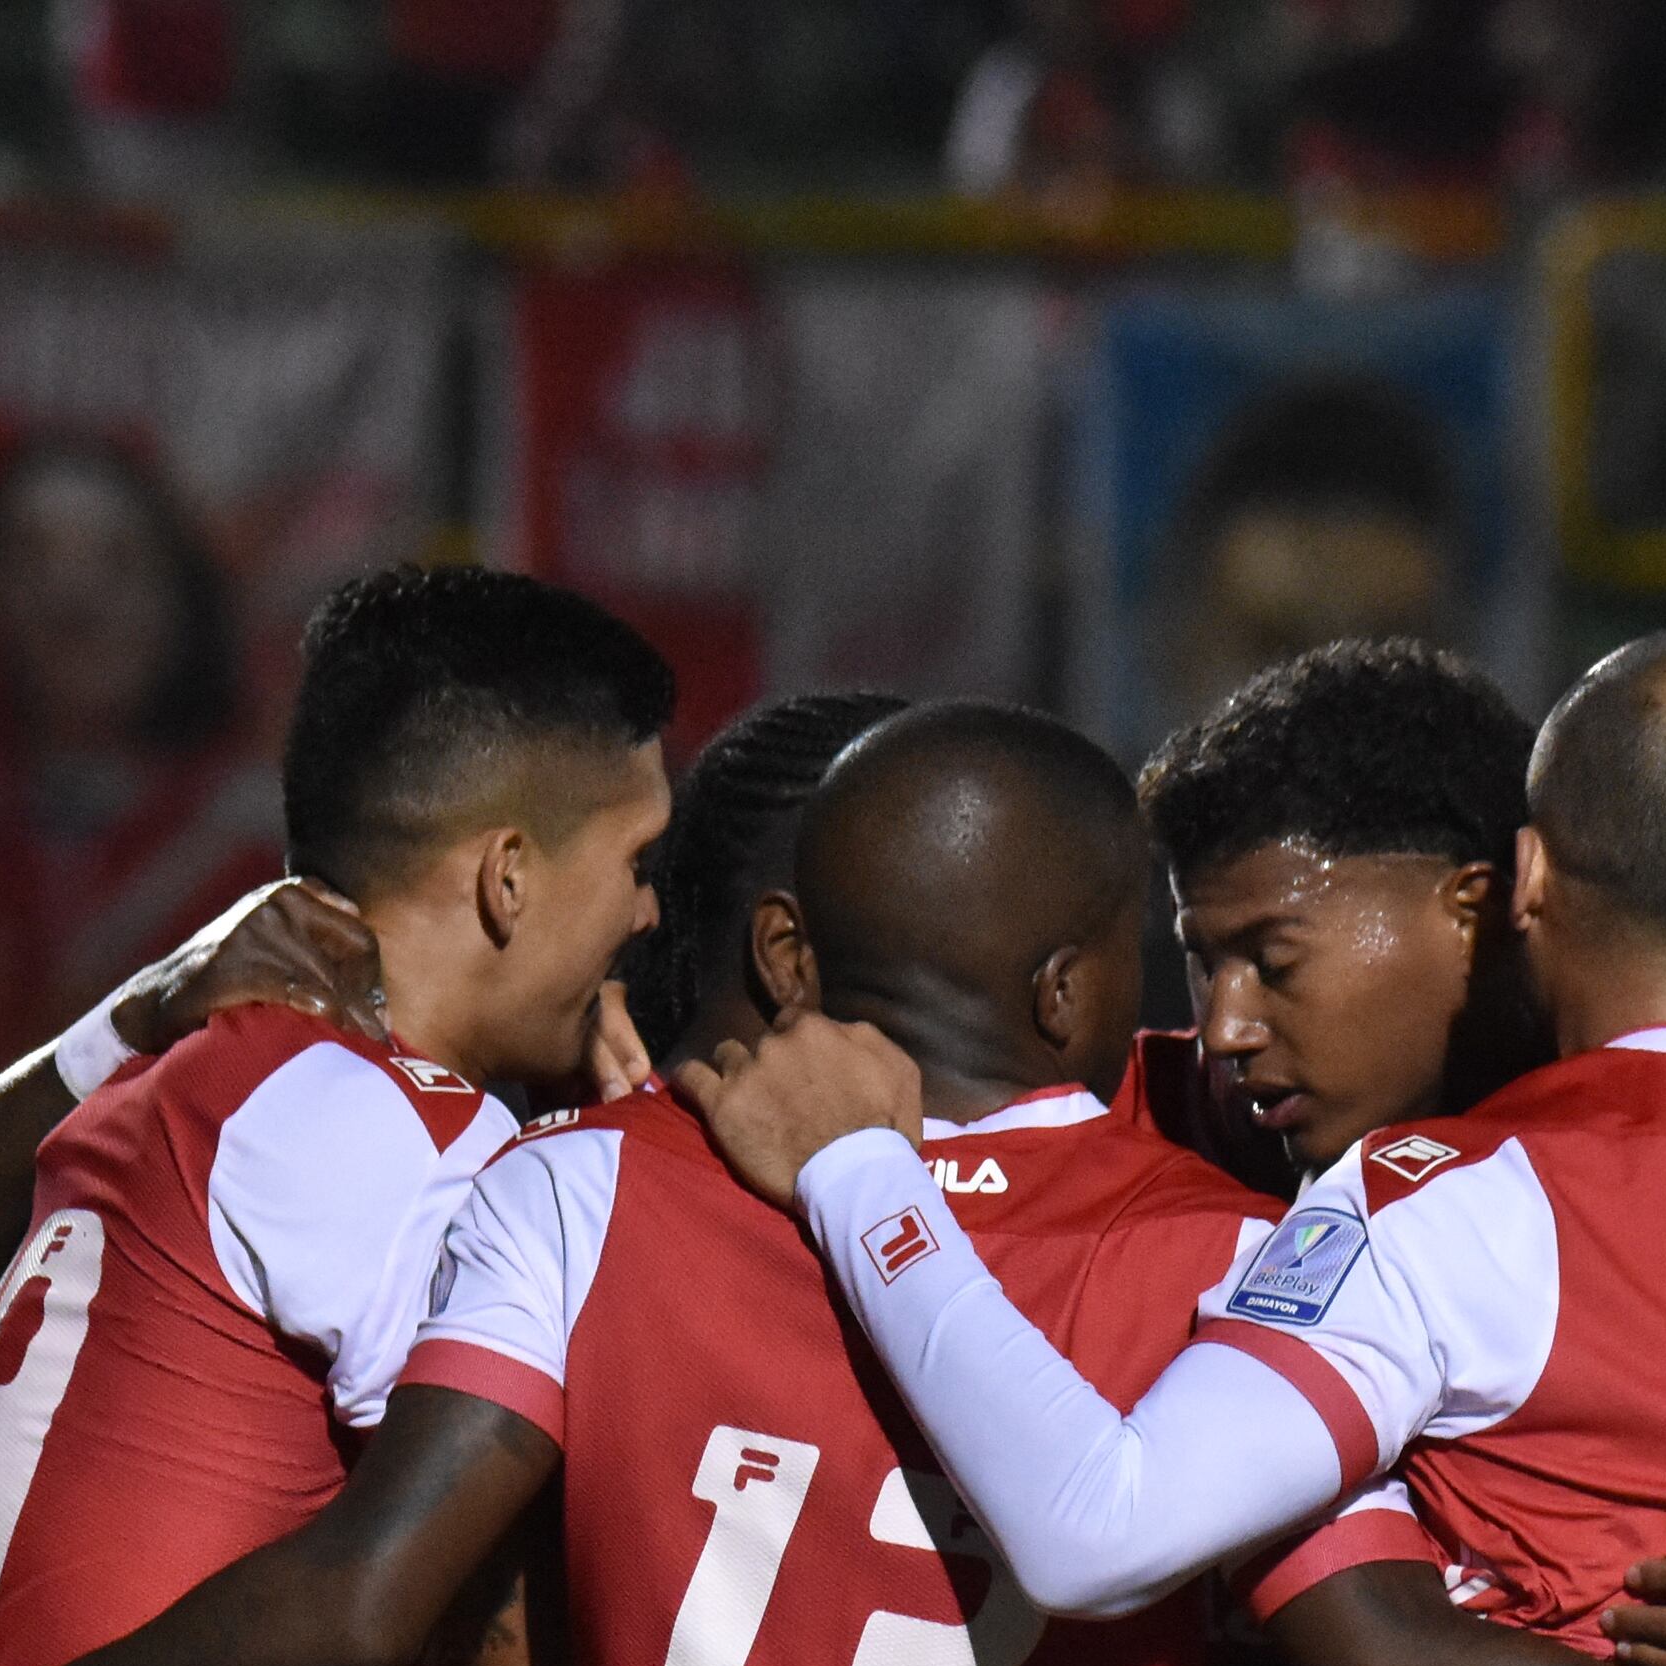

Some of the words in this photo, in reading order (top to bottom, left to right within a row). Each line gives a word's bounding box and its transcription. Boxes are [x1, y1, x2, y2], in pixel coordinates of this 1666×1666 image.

[923, 1157, 1010, 1194] ILA
[1253, 1271, 1321, 1297] BetPlay
[1246, 1296, 1299, 1315] DIMAYOR
